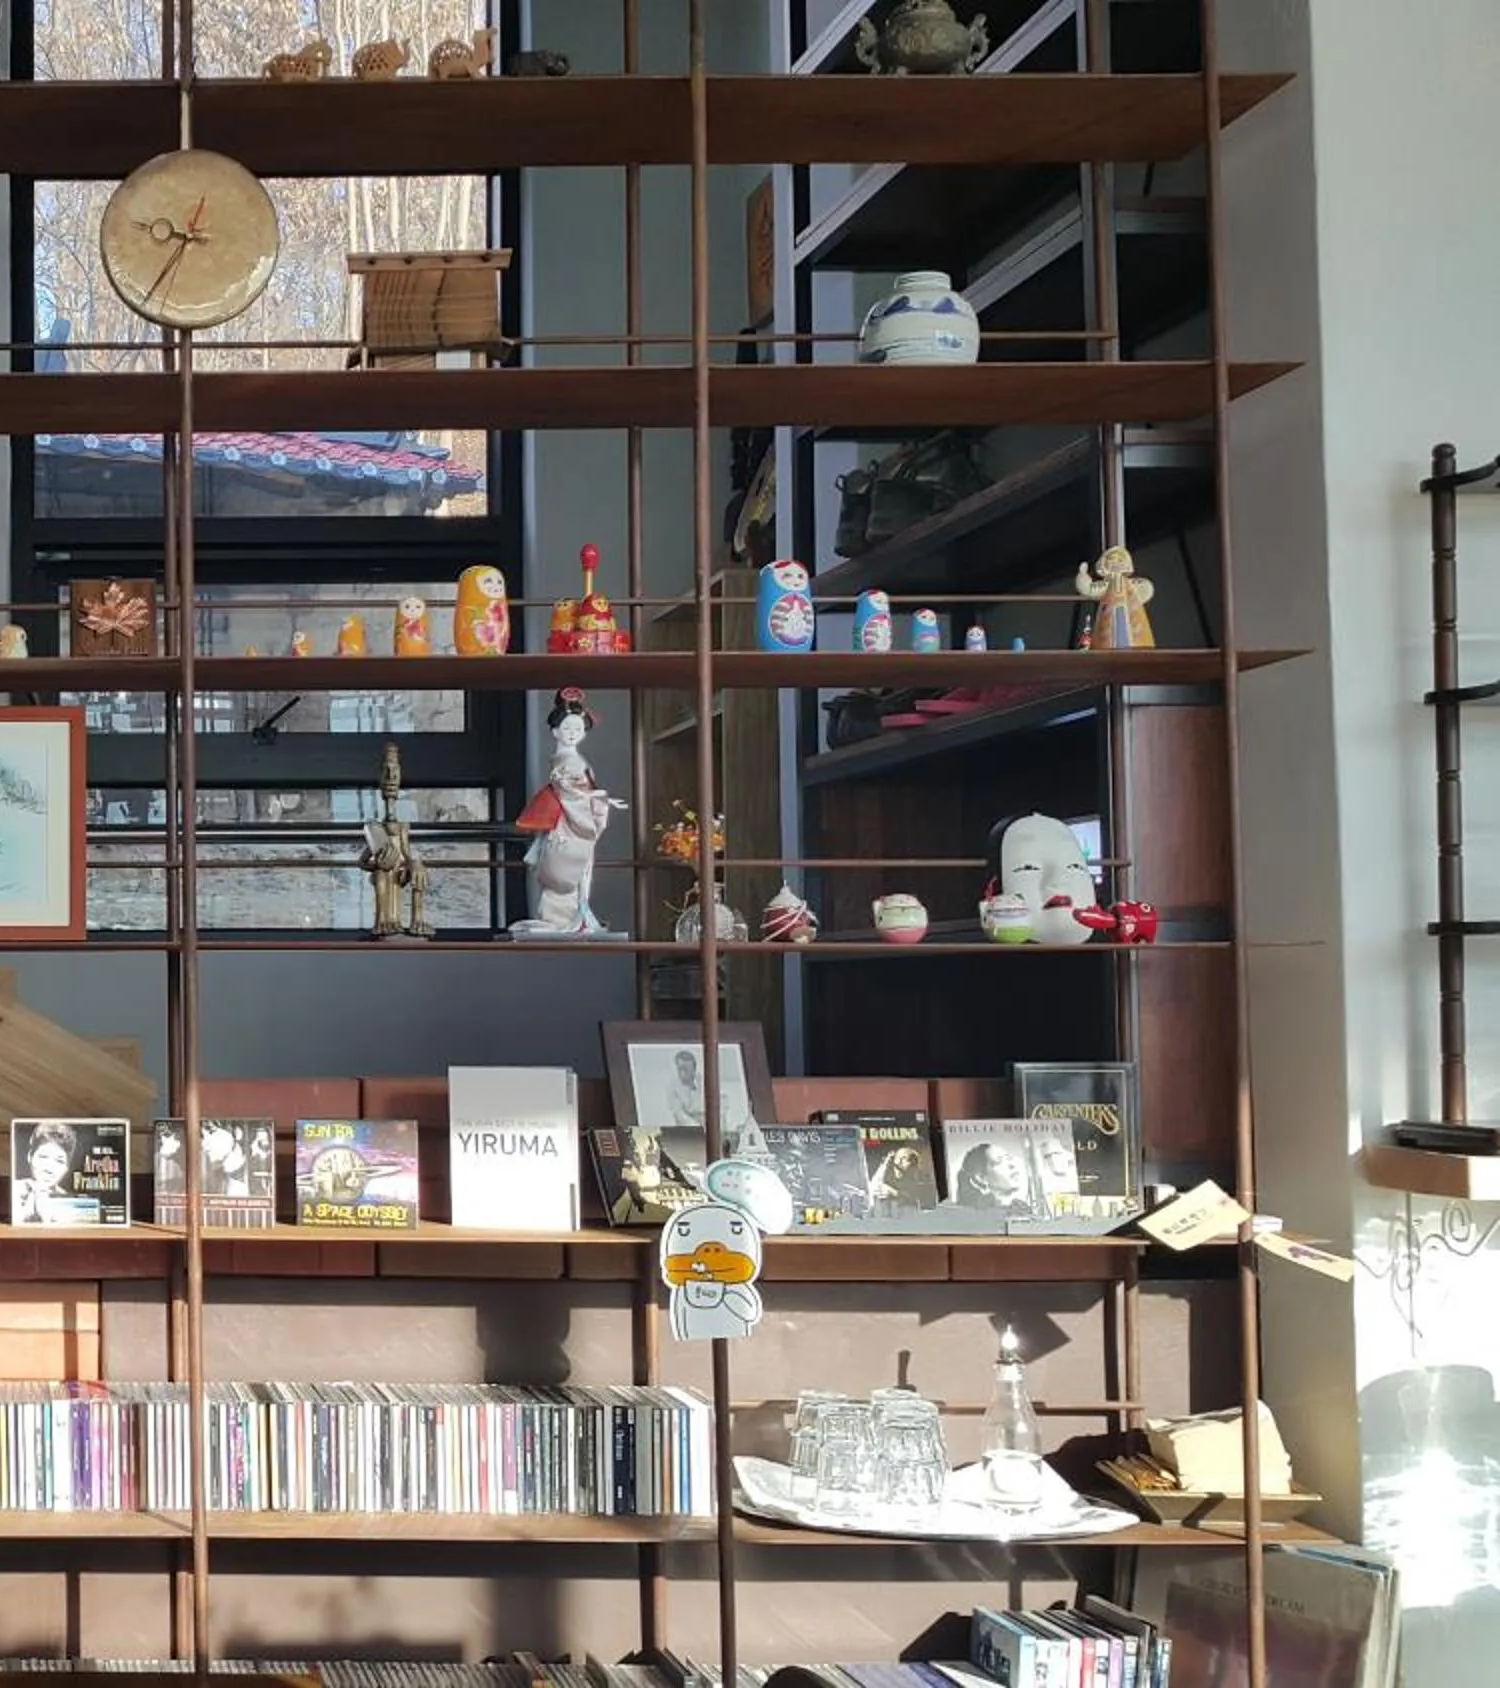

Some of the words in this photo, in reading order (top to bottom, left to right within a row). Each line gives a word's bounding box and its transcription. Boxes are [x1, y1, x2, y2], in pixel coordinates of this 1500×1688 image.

[949, 1123, 996, 1133] BILLIE
[1002, 1123, 1067, 1133] HOLIDAY
[1031, 1103, 1119, 1135] CARPENTERS
[457, 1132, 559, 1157] YIRUMA
[72, 1171, 121, 1192] Franklin
[303, 1203, 313, 1217] A
[315, 1203, 355, 1218] SPACE
[357, 1204, 409, 1221] ODYSSEY
